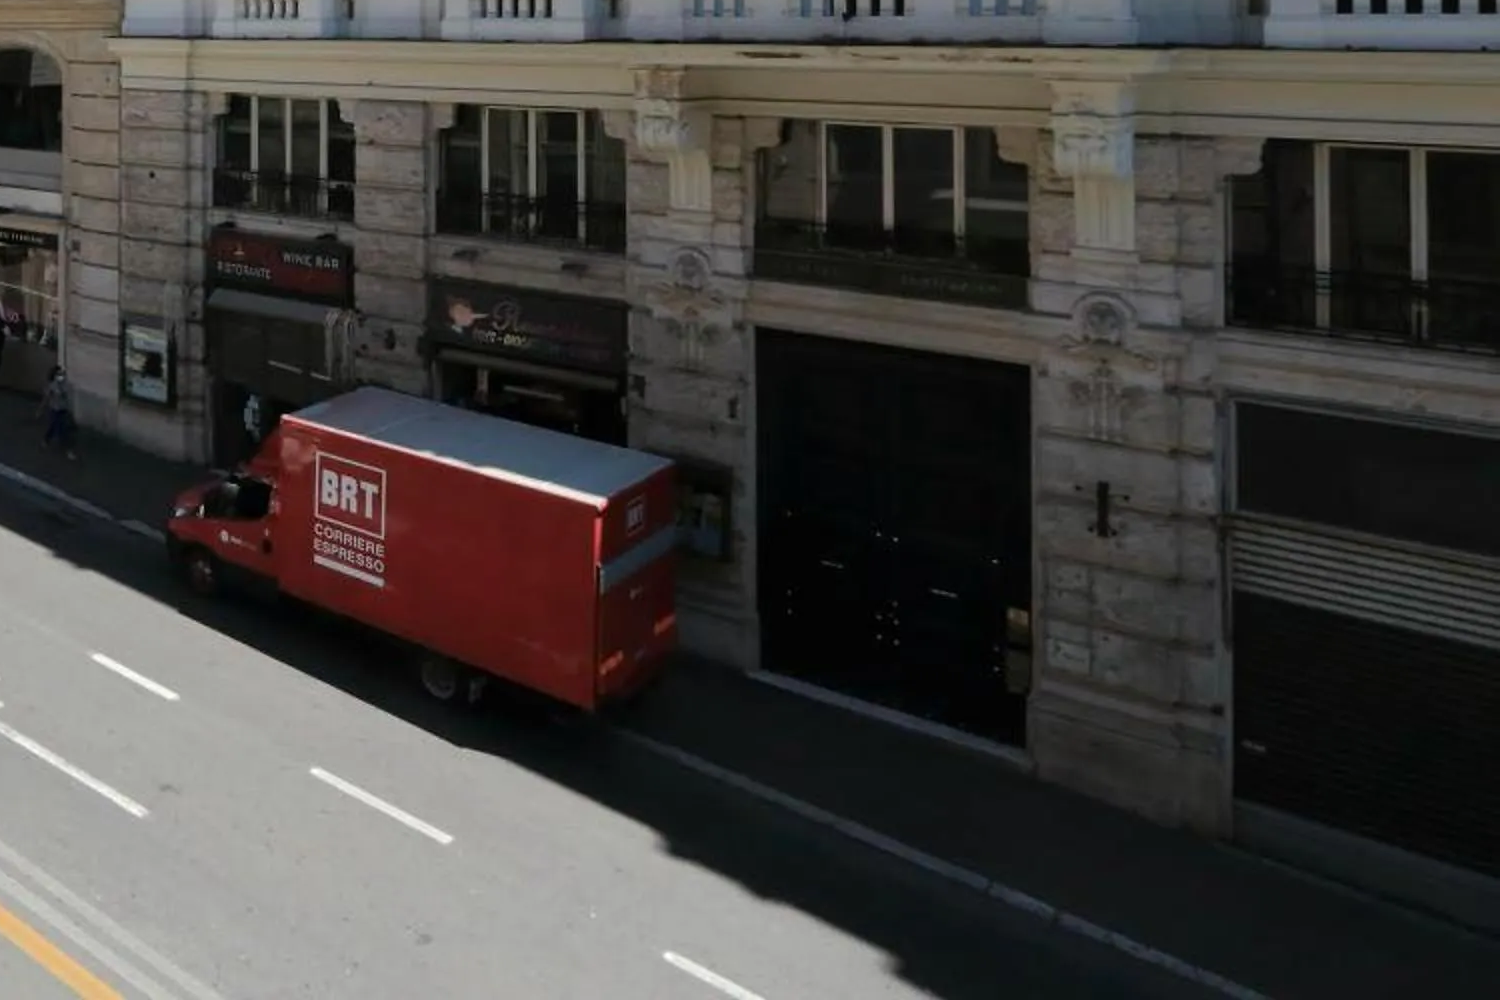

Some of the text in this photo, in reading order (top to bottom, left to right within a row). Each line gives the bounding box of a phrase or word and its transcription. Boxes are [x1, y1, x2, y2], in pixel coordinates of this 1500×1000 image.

[321, 469, 379, 519] BRT
[313, 522, 386, 558] CORRIERE
[313, 537, 386, 574] ESPRESSO
